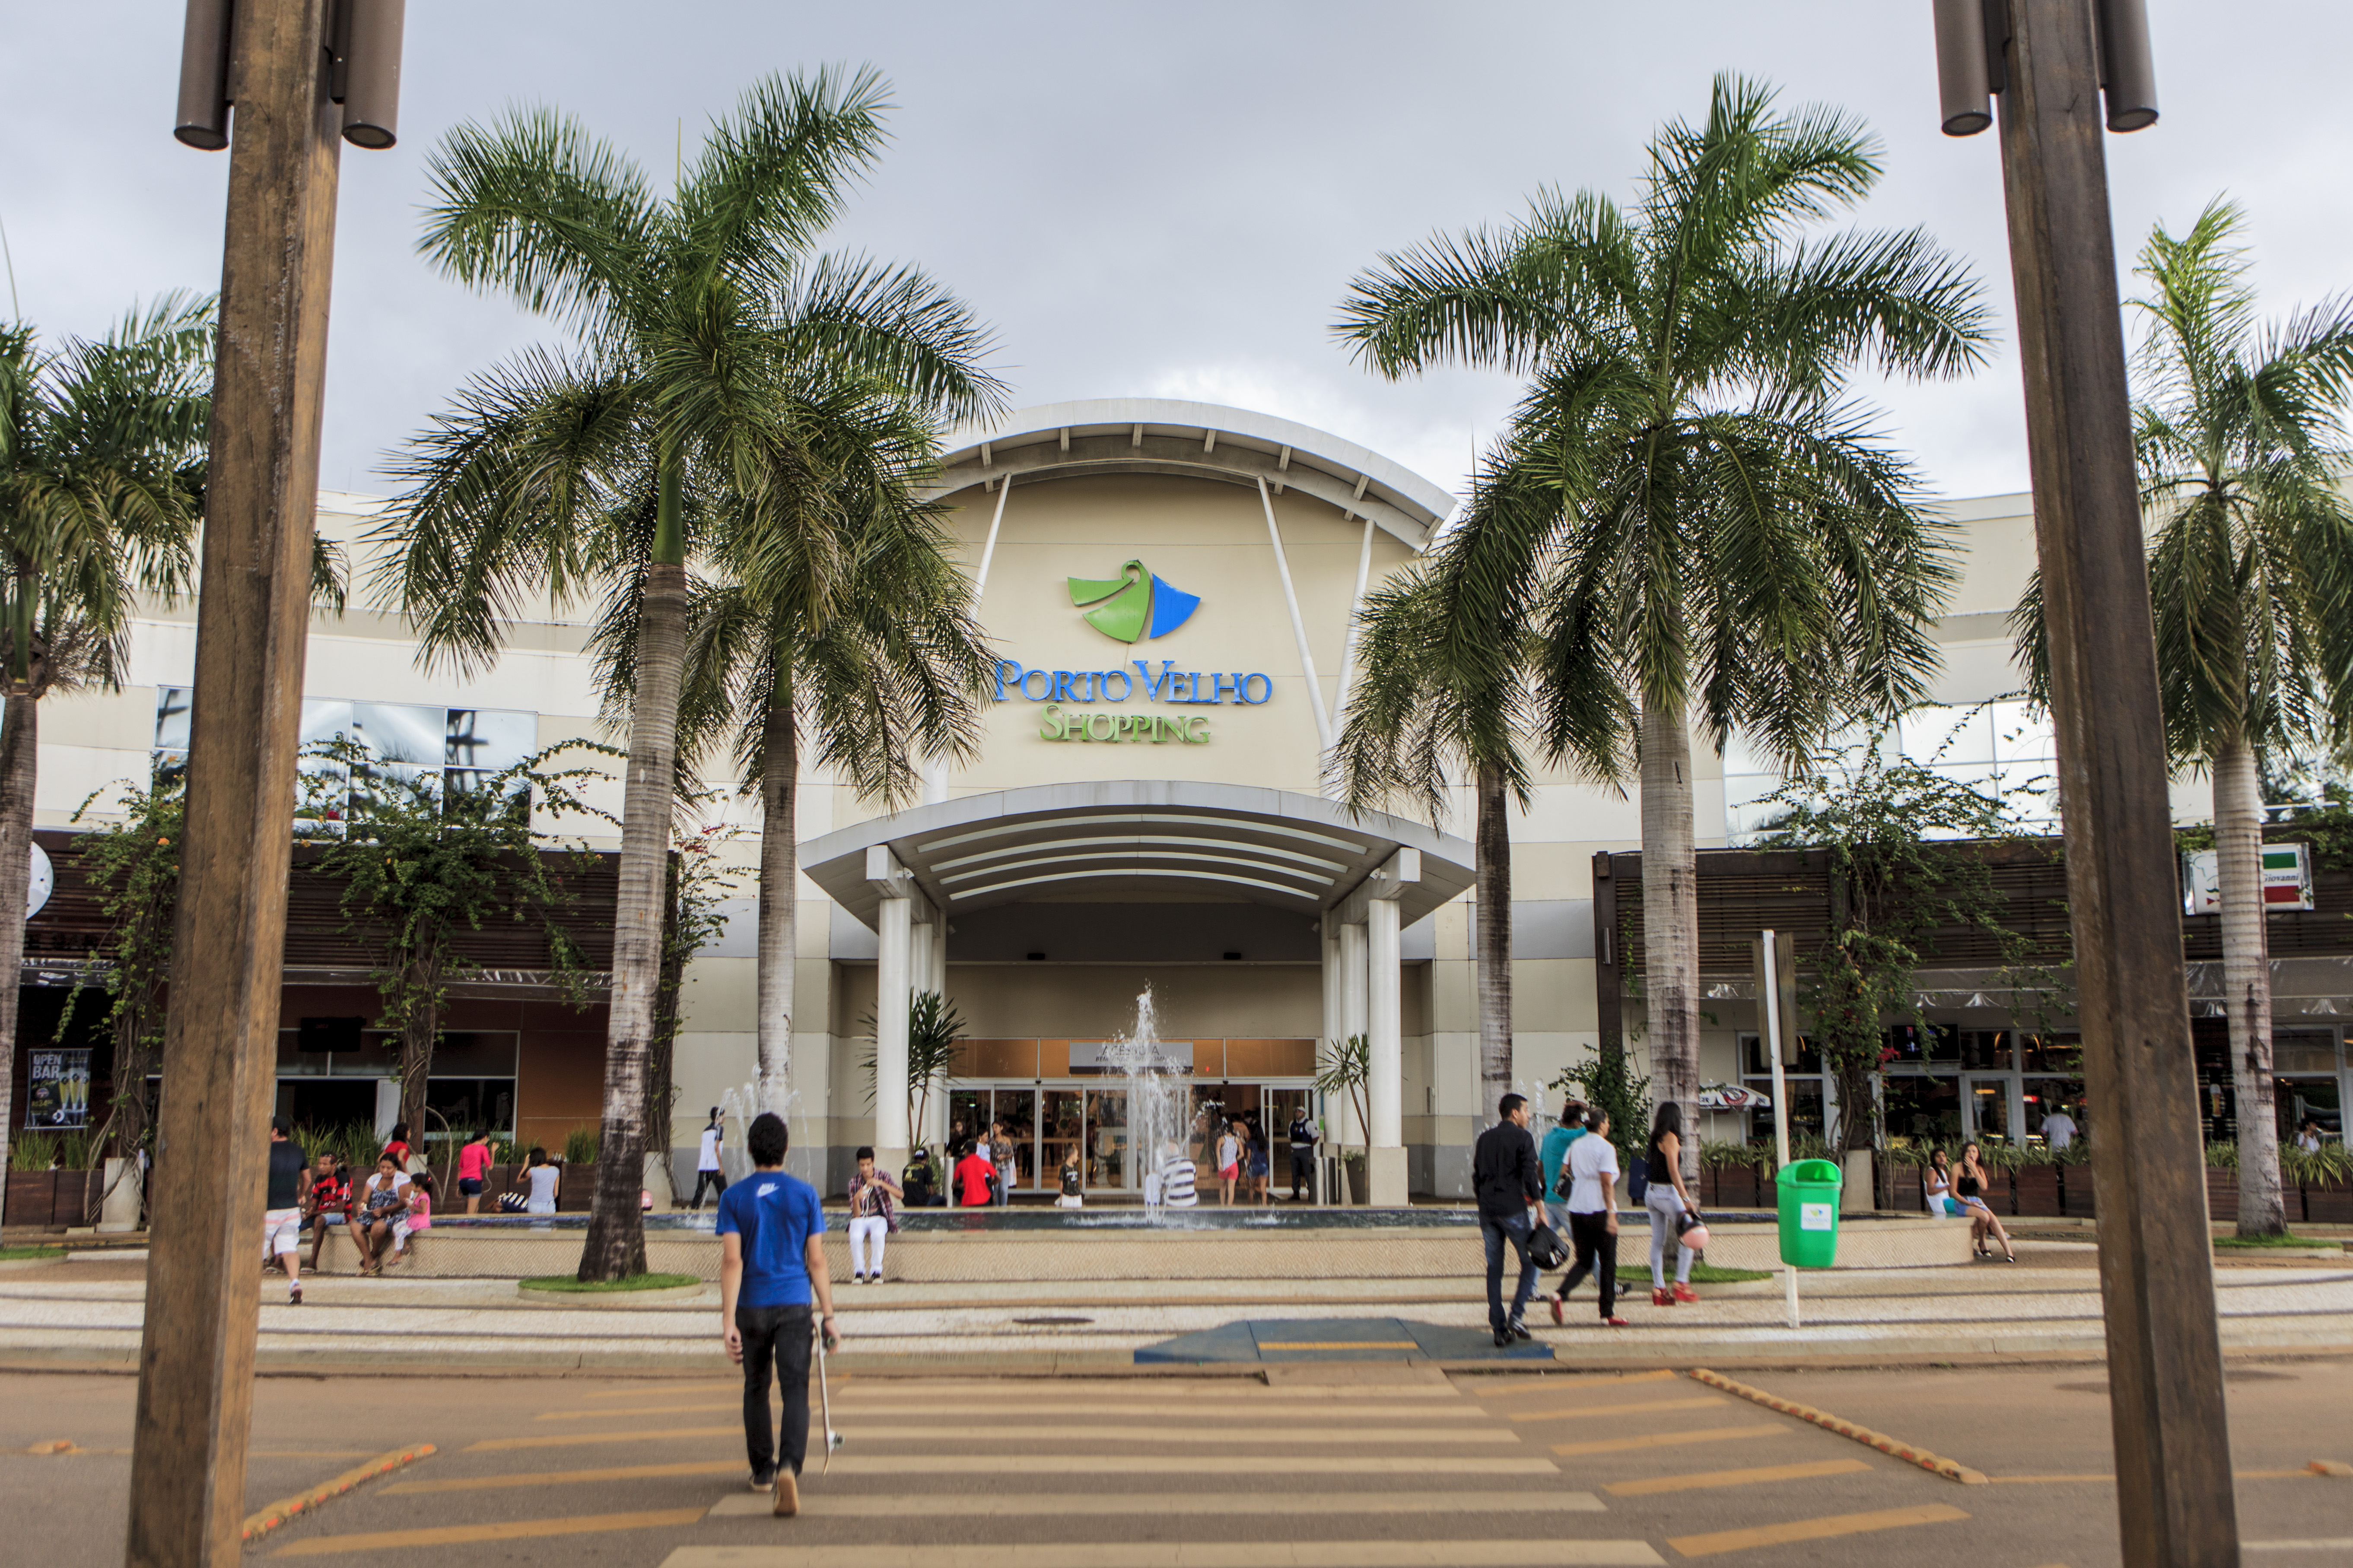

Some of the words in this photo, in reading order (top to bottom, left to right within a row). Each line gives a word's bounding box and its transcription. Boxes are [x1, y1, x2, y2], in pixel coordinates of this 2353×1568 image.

[992, 660, 1132, 703] PORTO
[1132, 660, 1273, 705] VELHO
[1040, 703, 1210, 743] SHOPPING
[32, 1065, 60, 1079] BAR
[33, 1054, 62, 1065] OPEN
